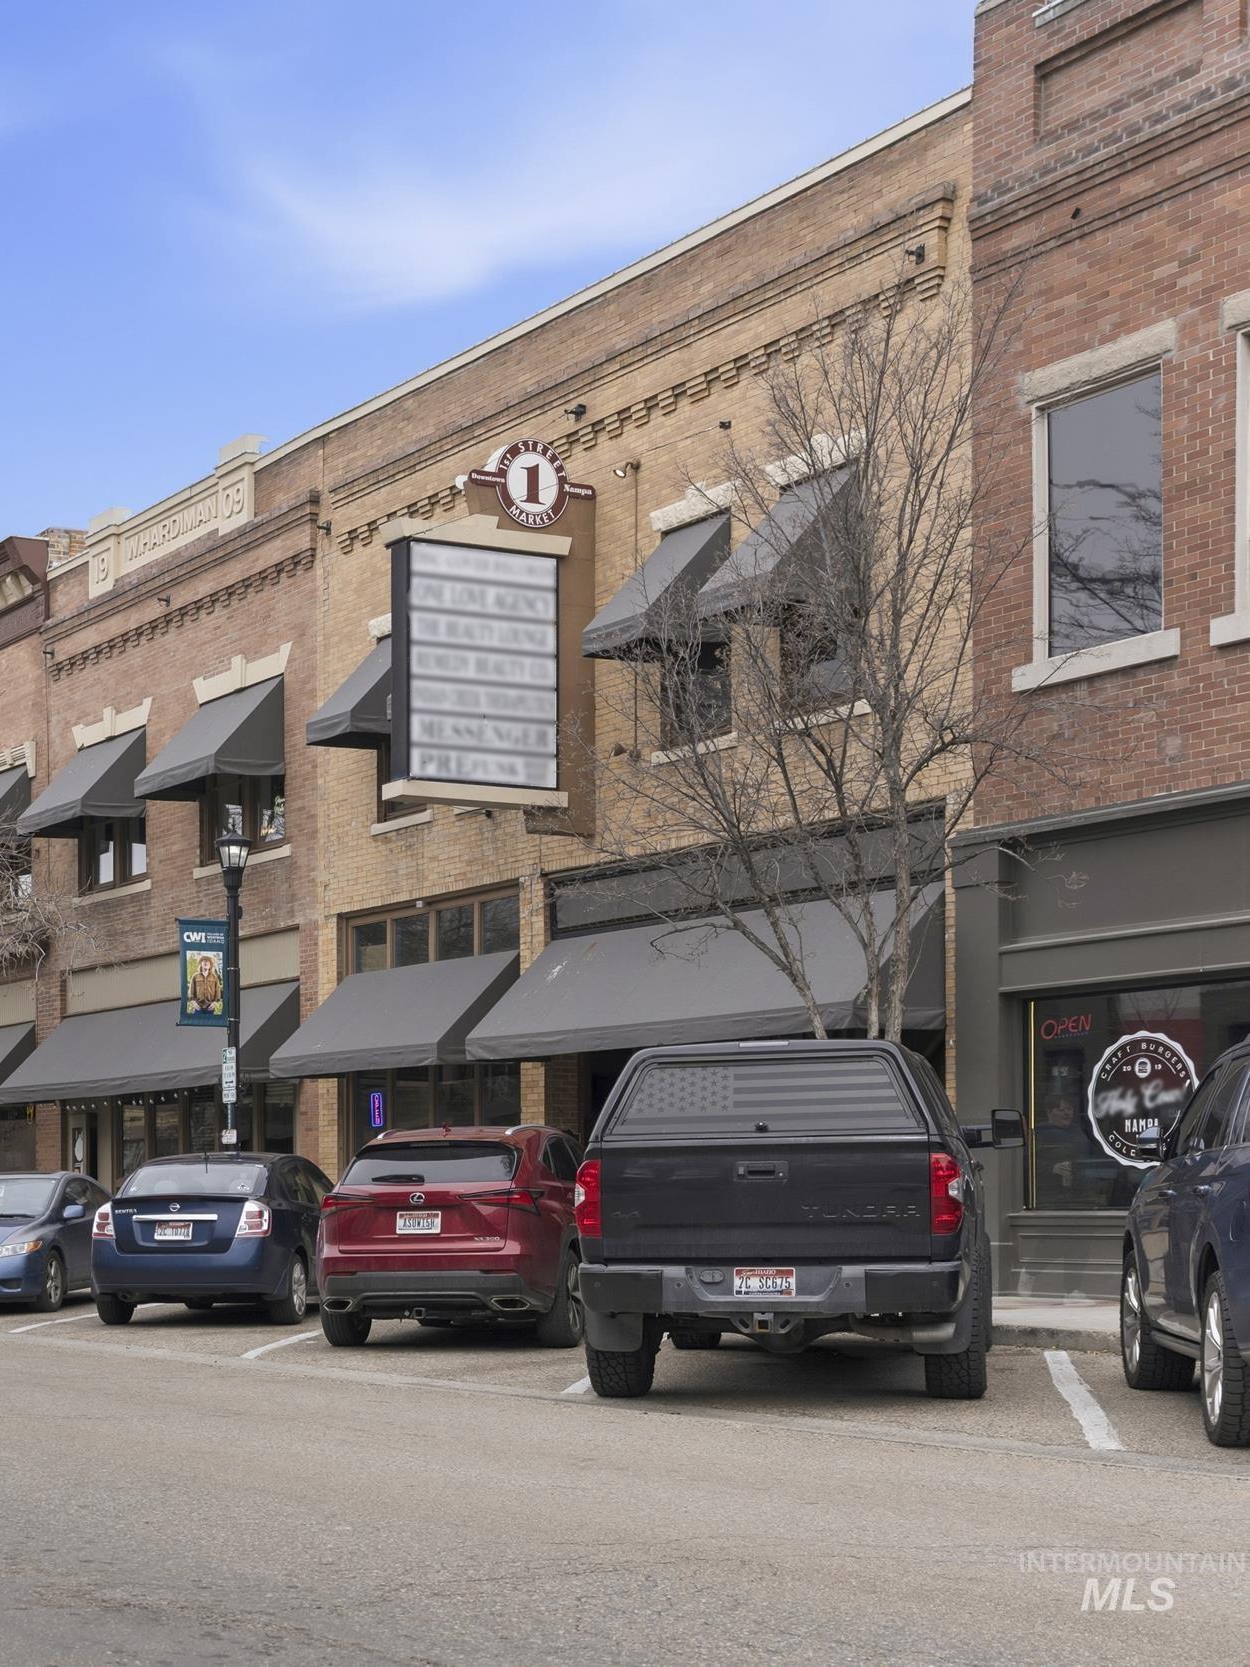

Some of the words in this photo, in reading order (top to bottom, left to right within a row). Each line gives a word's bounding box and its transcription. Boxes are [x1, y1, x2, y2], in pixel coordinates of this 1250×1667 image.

[500, 453, 513, 471] 1st
[518, 441, 566, 477] STREET
[471, 472, 506, 483] Downtown
[563, 484, 593, 496] Nampa
[520, 463, 546, 505] 1
[510, 505, 555, 525] MARKET
[94, 553, 109, 584] 19
[222, 485, 245, 519] 09
[183, 931, 206, 943] CWI
[1040, 1014, 1092, 1040] OPEN
[1100, 1045, 1132, 1079] CRAFT
[1141, 1042, 1186, 1078] BURGERS
[738, 1276, 751, 1289] 2C
[758, 1276, 791, 1289] SC675
